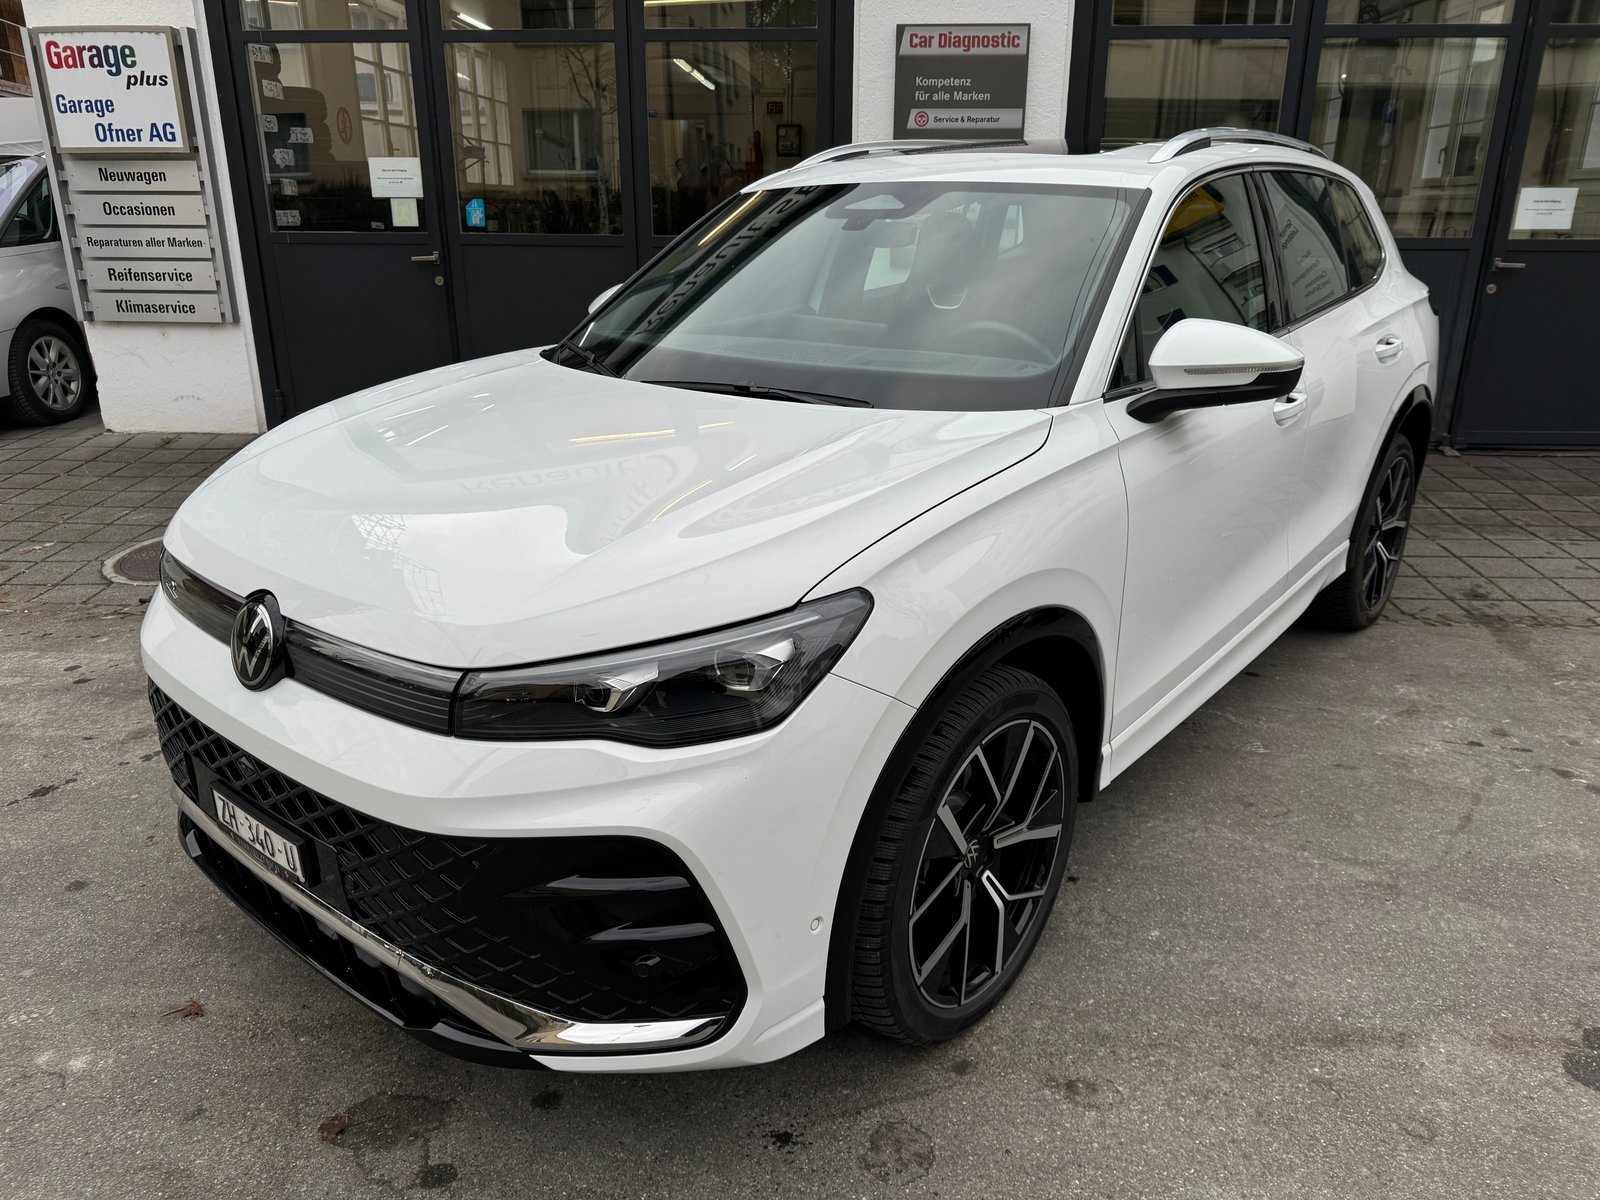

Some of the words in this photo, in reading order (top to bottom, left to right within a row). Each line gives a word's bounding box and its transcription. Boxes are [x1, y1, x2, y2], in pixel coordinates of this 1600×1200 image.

[909, 32, 934, 49] Car
[938, 30, 1021, 52] Diagnostic
[45, 40, 137, 76] Garage
[126, 70, 169, 90] plus
[915, 76, 972, 88] Kompetenz
[914, 90, 930, 101] für
[932, 90, 950, 101] alle
[953, 90, 991, 101] Marken
[55, 94, 115, 118] Garage
[933, 115, 959, 123] Service
[960, 115, 965, 123] &
[966, 115, 1001, 124] Reparatur
[94, 122, 143, 143] Ofner
[149, 122, 177, 142] AG
[98, 167, 167, 185] Neuwagen
[102, 201, 175, 217] Occasionen
[86, 236, 143, 249] Reparaturen
[145, 237, 166, 248] aller
[167, 237, 203, 248] Marken
[107, 267, 193, 282] Reifenservice
[115, 299, 196, 315] Klimaservice
